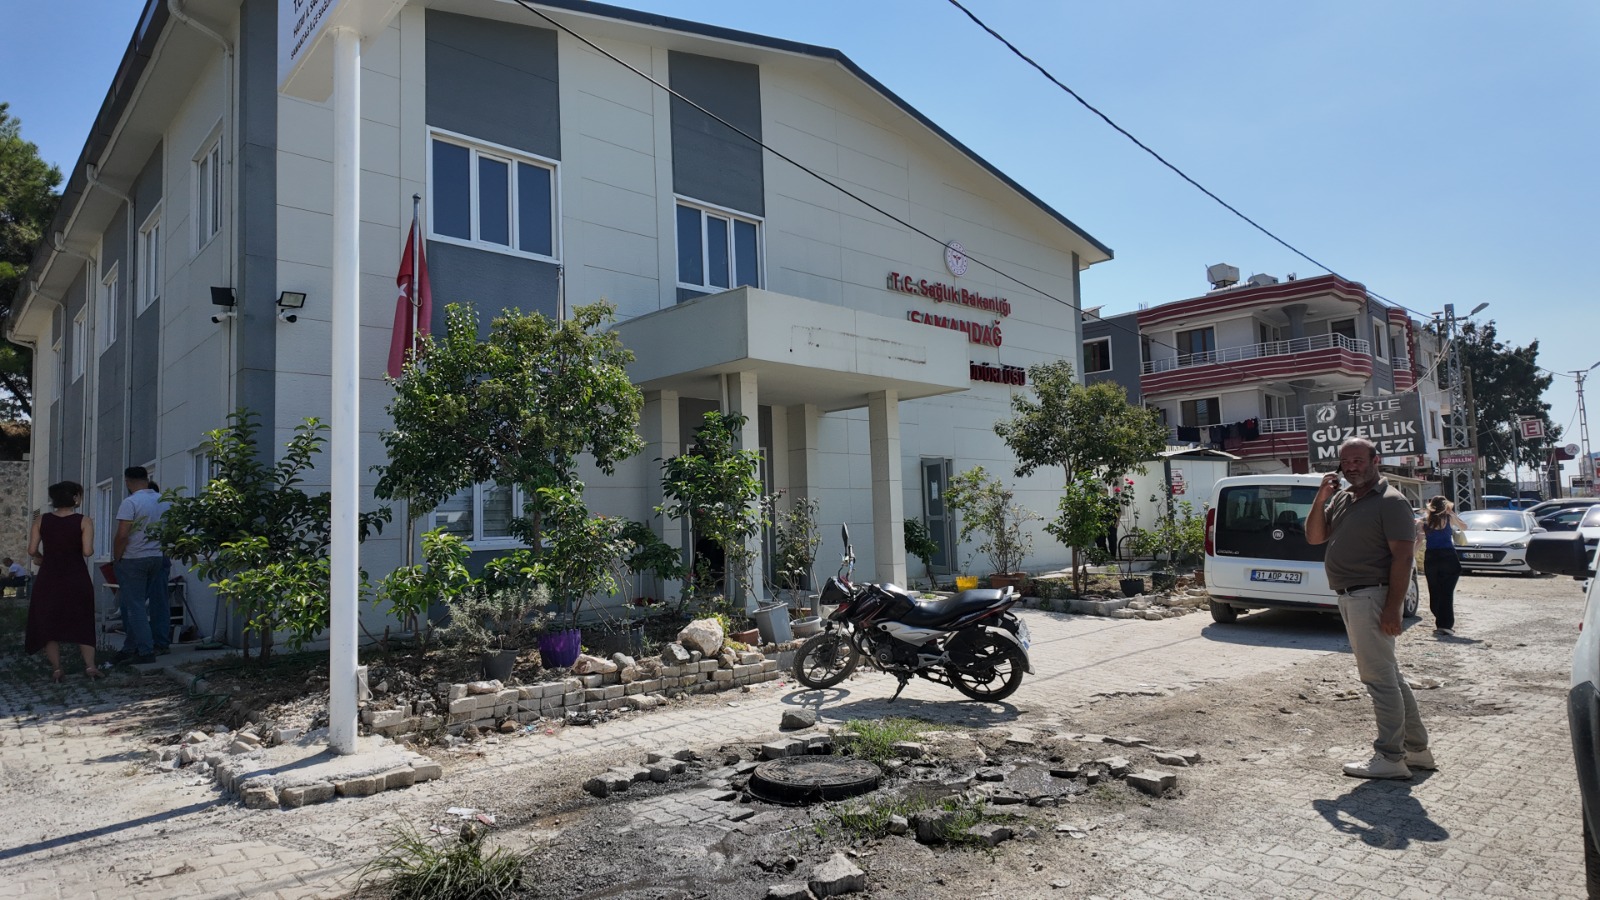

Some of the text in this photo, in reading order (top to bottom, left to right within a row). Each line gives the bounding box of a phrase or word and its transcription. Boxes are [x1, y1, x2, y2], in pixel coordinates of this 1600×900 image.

[891, 271, 1011, 316] T.C. Sağlık Bakanlığı
[1348, 398, 1401, 415] ESTE
[1526, 423, 1537, 434] E
[1256, 571, 1265, 580] 31
[1284, 573, 1299, 581] 423
